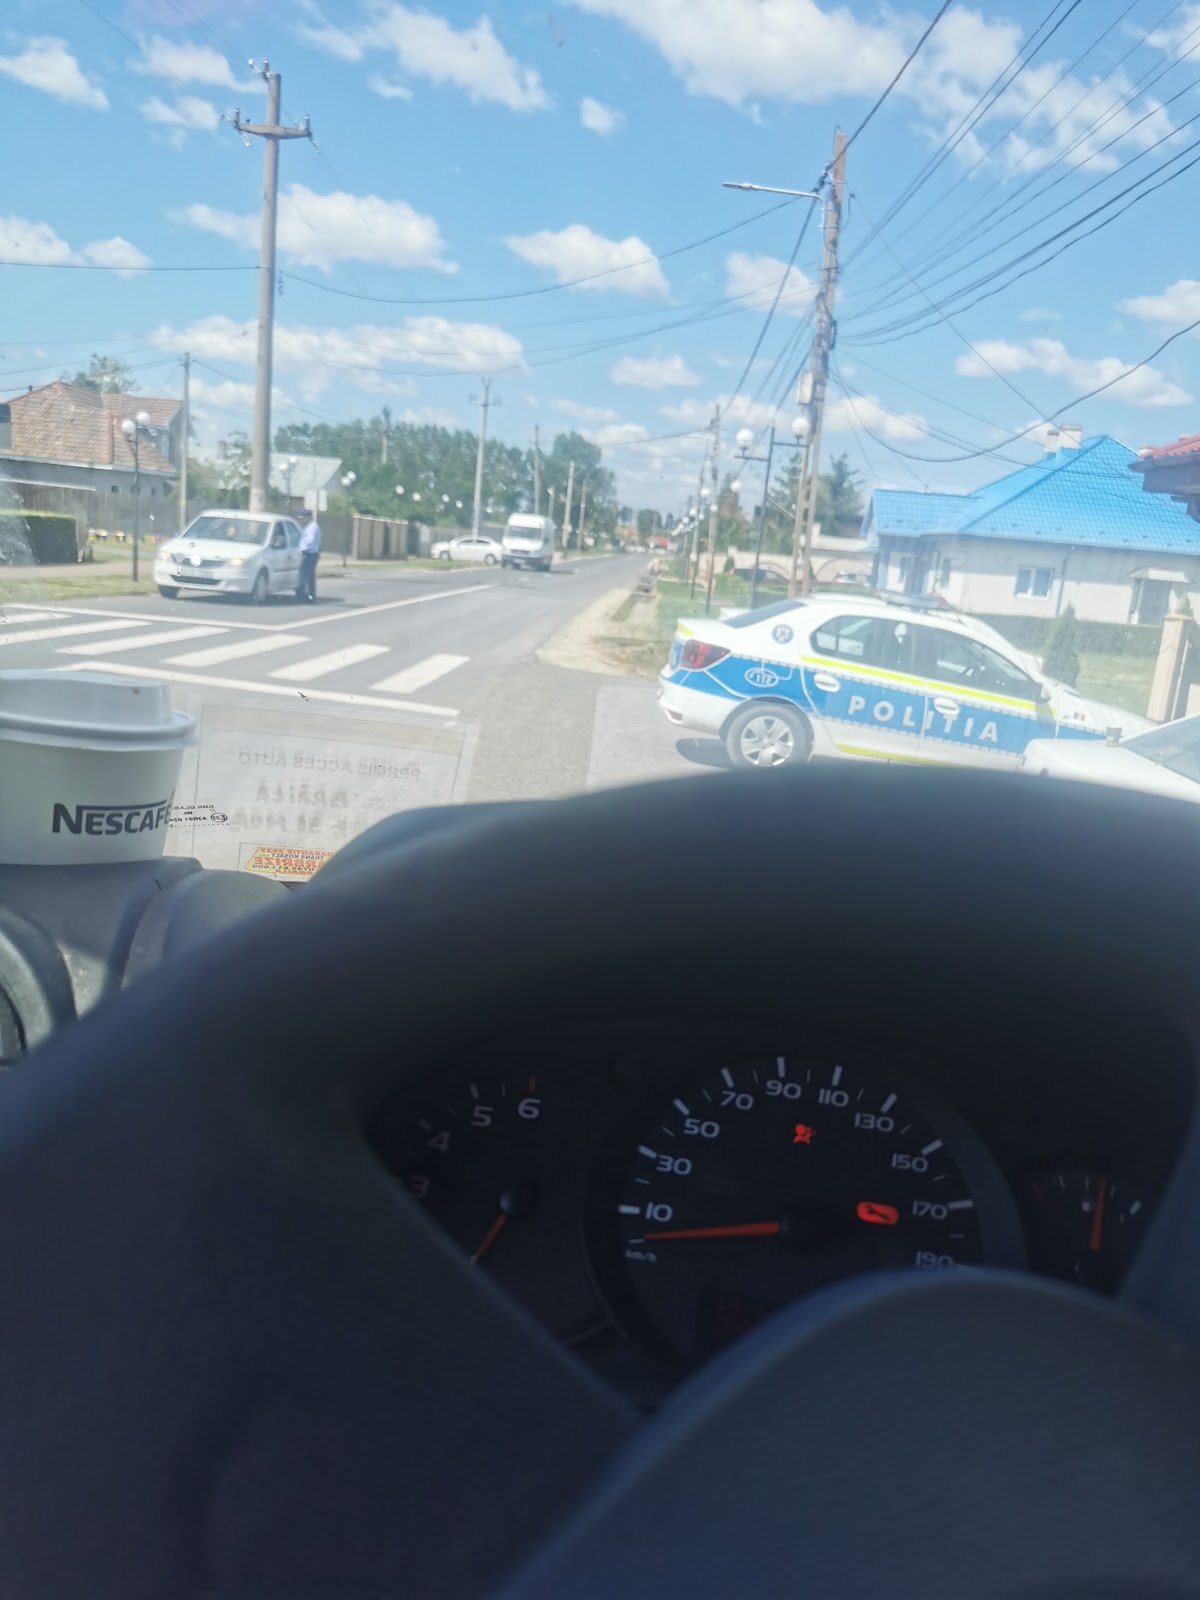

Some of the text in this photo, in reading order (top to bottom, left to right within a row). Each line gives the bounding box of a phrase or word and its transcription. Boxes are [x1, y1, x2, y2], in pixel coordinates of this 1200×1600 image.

[756, 674, 772, 685] 112
[765, 1079, 802, 1099] 90
[818, 1088, 849, 1107] 110
[517, 1097, 541, 1119] 6
[720, 1090, 754, 1110] 70
[471, 1104, 494, 1127] 5
[854, 1112, 894, 1133] 130
[683, 1118, 720, 1138] 50
[427, 1131, 450, 1152] 4
[656, 1154, 692, 1175] 30
[891, 1153, 928, 1172] 150
[645, 1202, 673, 1222] 10
[912, 1200, 948, 1220] 170
[625, 1249, 657, 1263] km/h
